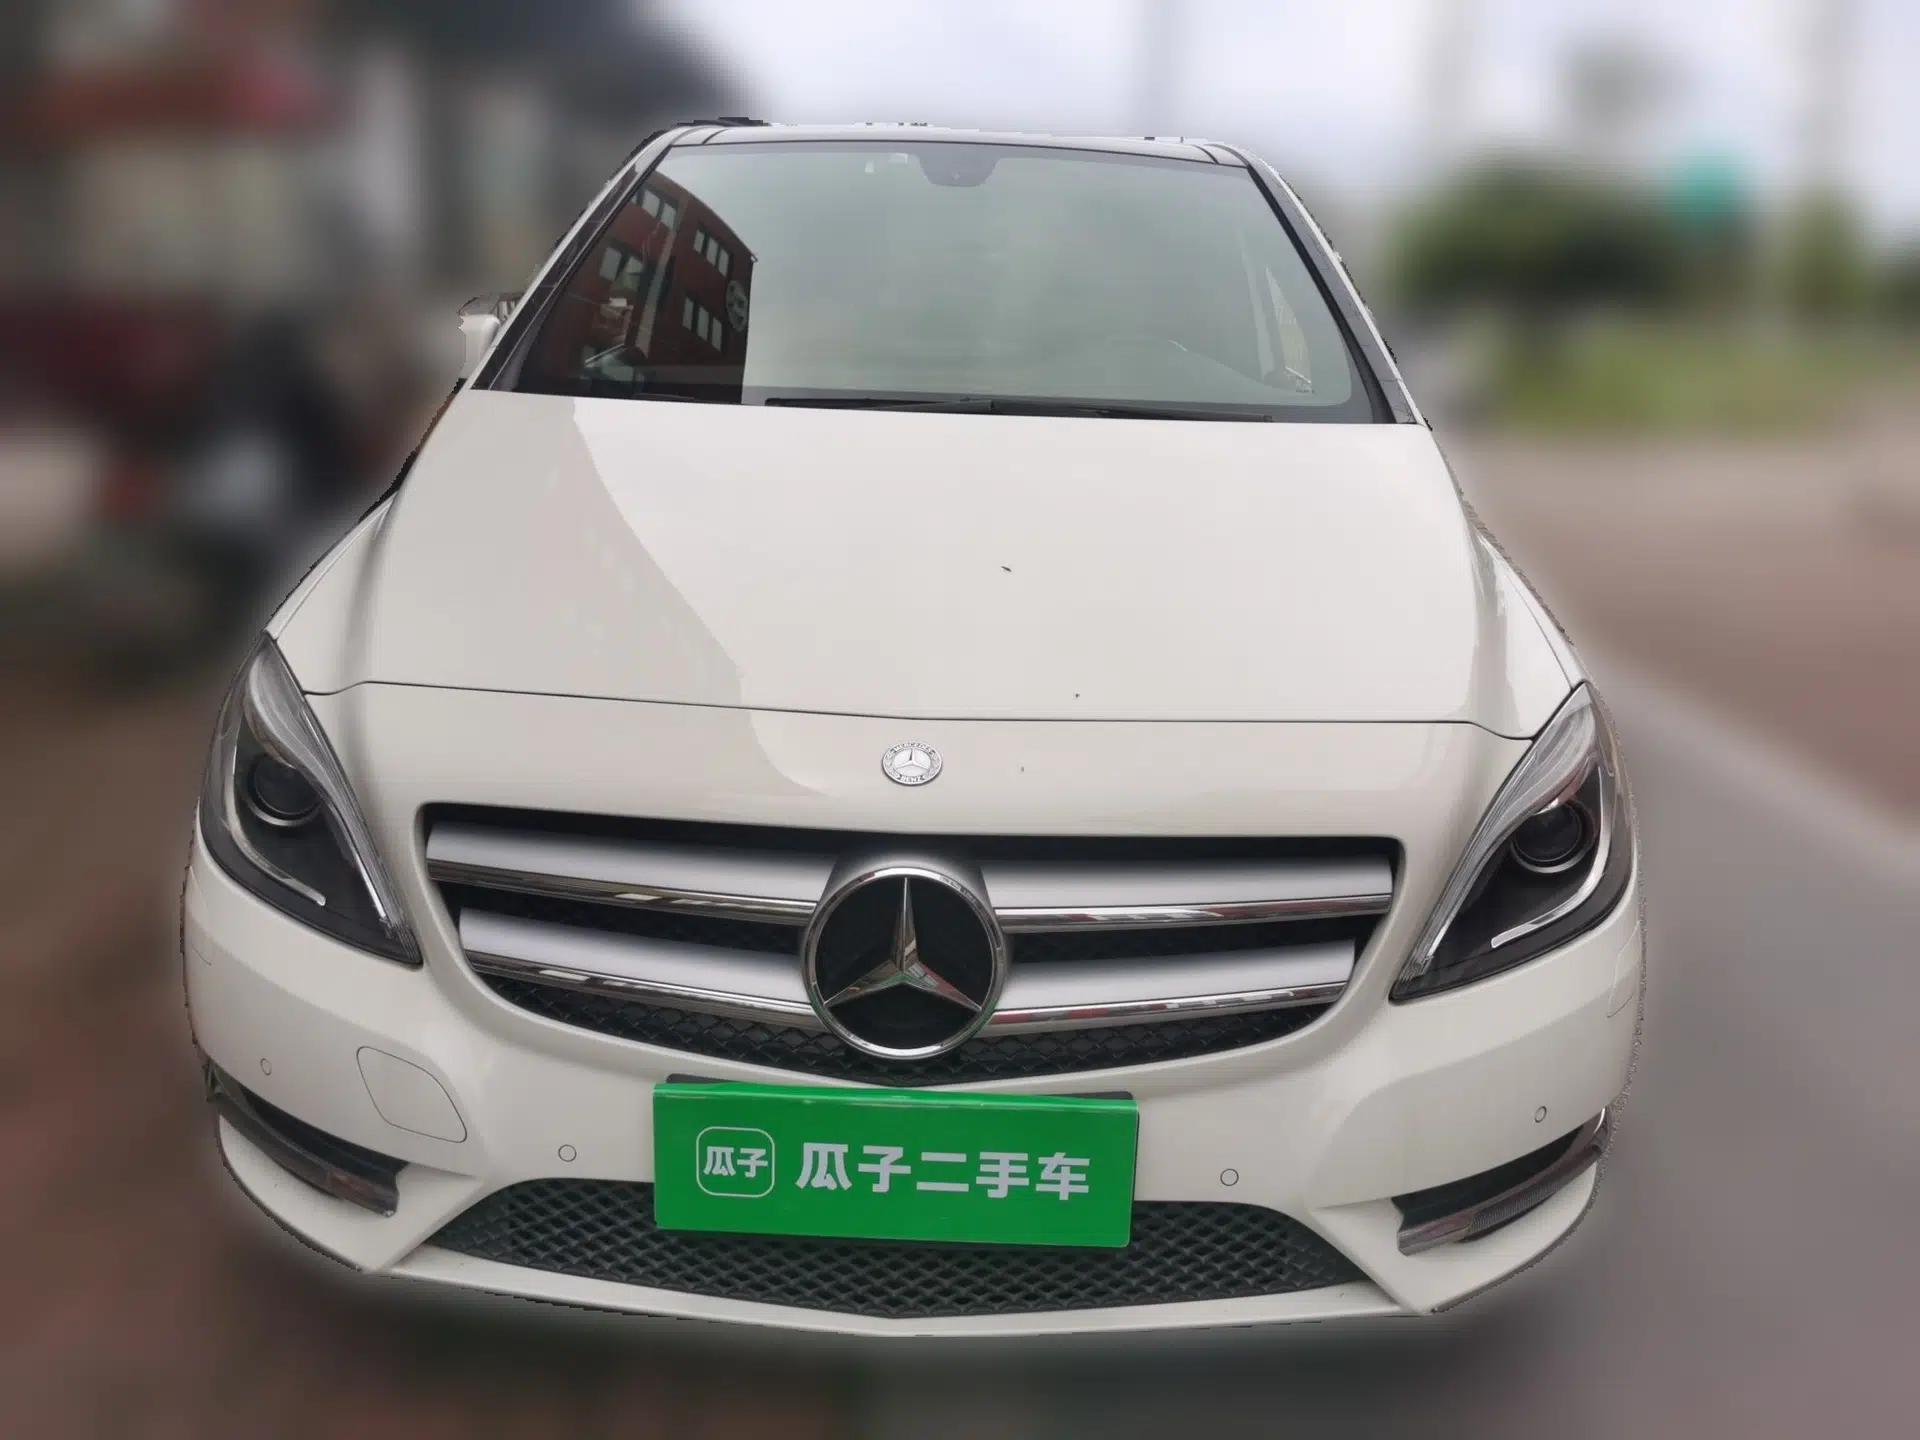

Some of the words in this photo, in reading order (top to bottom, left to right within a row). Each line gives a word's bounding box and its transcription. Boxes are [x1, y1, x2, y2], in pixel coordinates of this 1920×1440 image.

[703, 1146, 769, 1178] 瓜子
[796, 1142, 1090, 1201] 瓜子二手车
